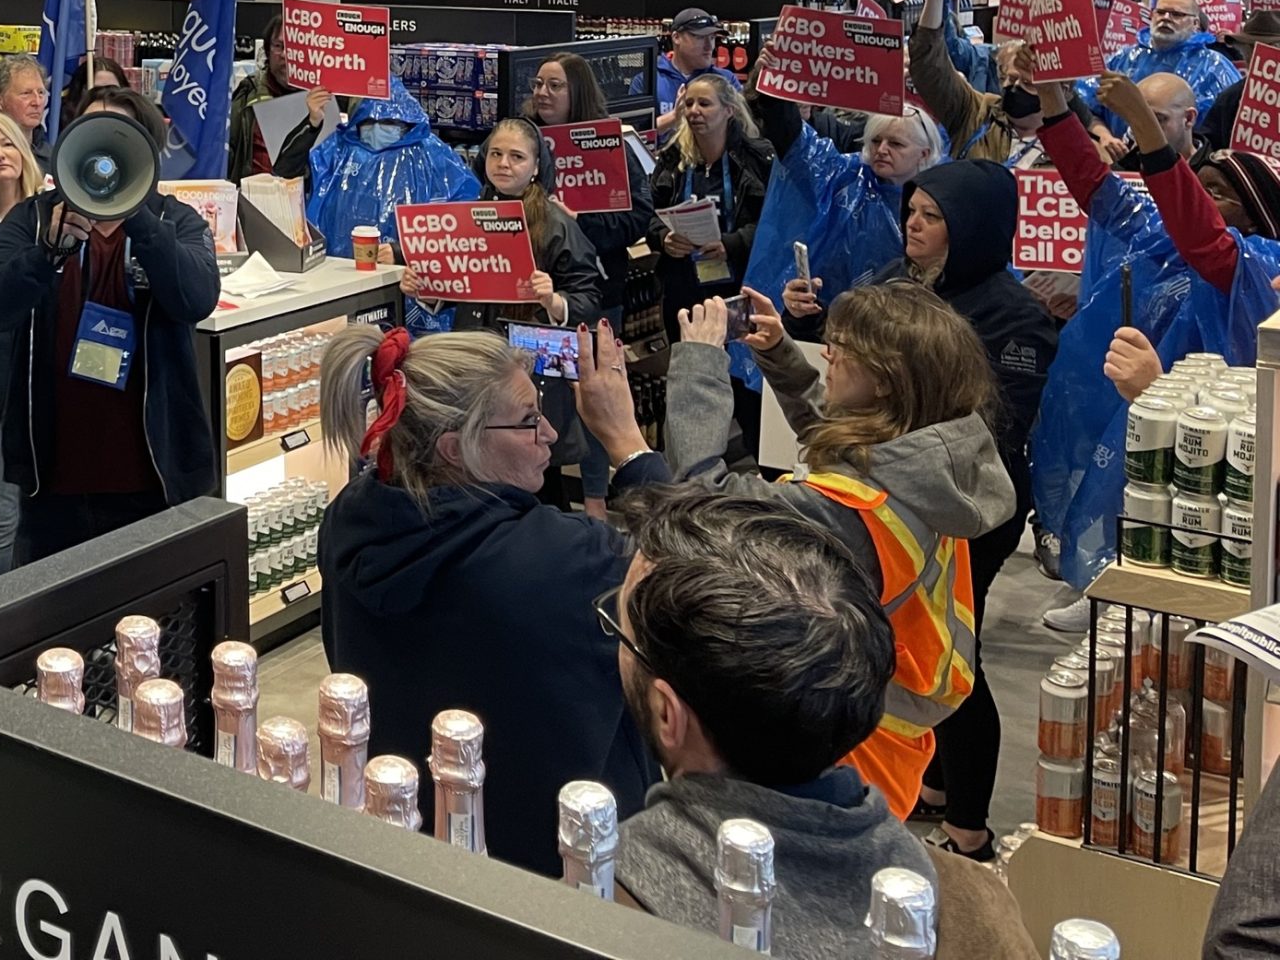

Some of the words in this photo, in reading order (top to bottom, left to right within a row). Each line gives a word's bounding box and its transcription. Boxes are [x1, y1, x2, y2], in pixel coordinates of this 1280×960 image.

[285, 7, 323, 28] LCBO
[337, 11, 361, 20] ENOUGH
[1001, 5, 1024, 20] are
[344, 23, 385, 35] ENOUGH
[389, 20, 417, 32] ERS
[775, 15, 826, 38] LCBO
[844, 21, 872, 32] ENOUGH
[1042, 14, 1083, 43] Worth
[285, 26, 345, 51] Workers
[772, 33, 856, 62] Workers
[854, 35, 900, 48] ENOUGH
[286, 47, 305, 63] are
[307, 50, 366, 71] Worth
[1253, 55, 1280, 83] LC
[287, 63, 321, 86] More!
[770, 56, 803, 74] are
[808, 58, 879, 86] Worth
[762, 71, 829, 98] More!
[1239, 105, 1271, 129] are
[571, 129, 595, 138] ENOUGH
[580, 138, 620, 150] ENOUGH
[1018, 175, 1069, 195] The
[472, 210, 497, 218] ENOUGH
[1019, 196, 1088, 219] LCB
[401, 213, 458, 234] LCBO
[483, 221, 523, 232] ENOUGH
[404, 234, 488, 254] Workers
[1019, 241, 1054, 263] all
[1061, 247, 1085, 264] o
[410, 259, 442, 274] are
[445, 254, 512, 274] Worth
[419, 275, 472, 294] More!
[1178, 443, 1209, 457] MOJITO
[1183, 435, 1202, 448] RUM
[1182, 516, 1202, 526] RUM
[1231, 525, 1252, 537] RUM
